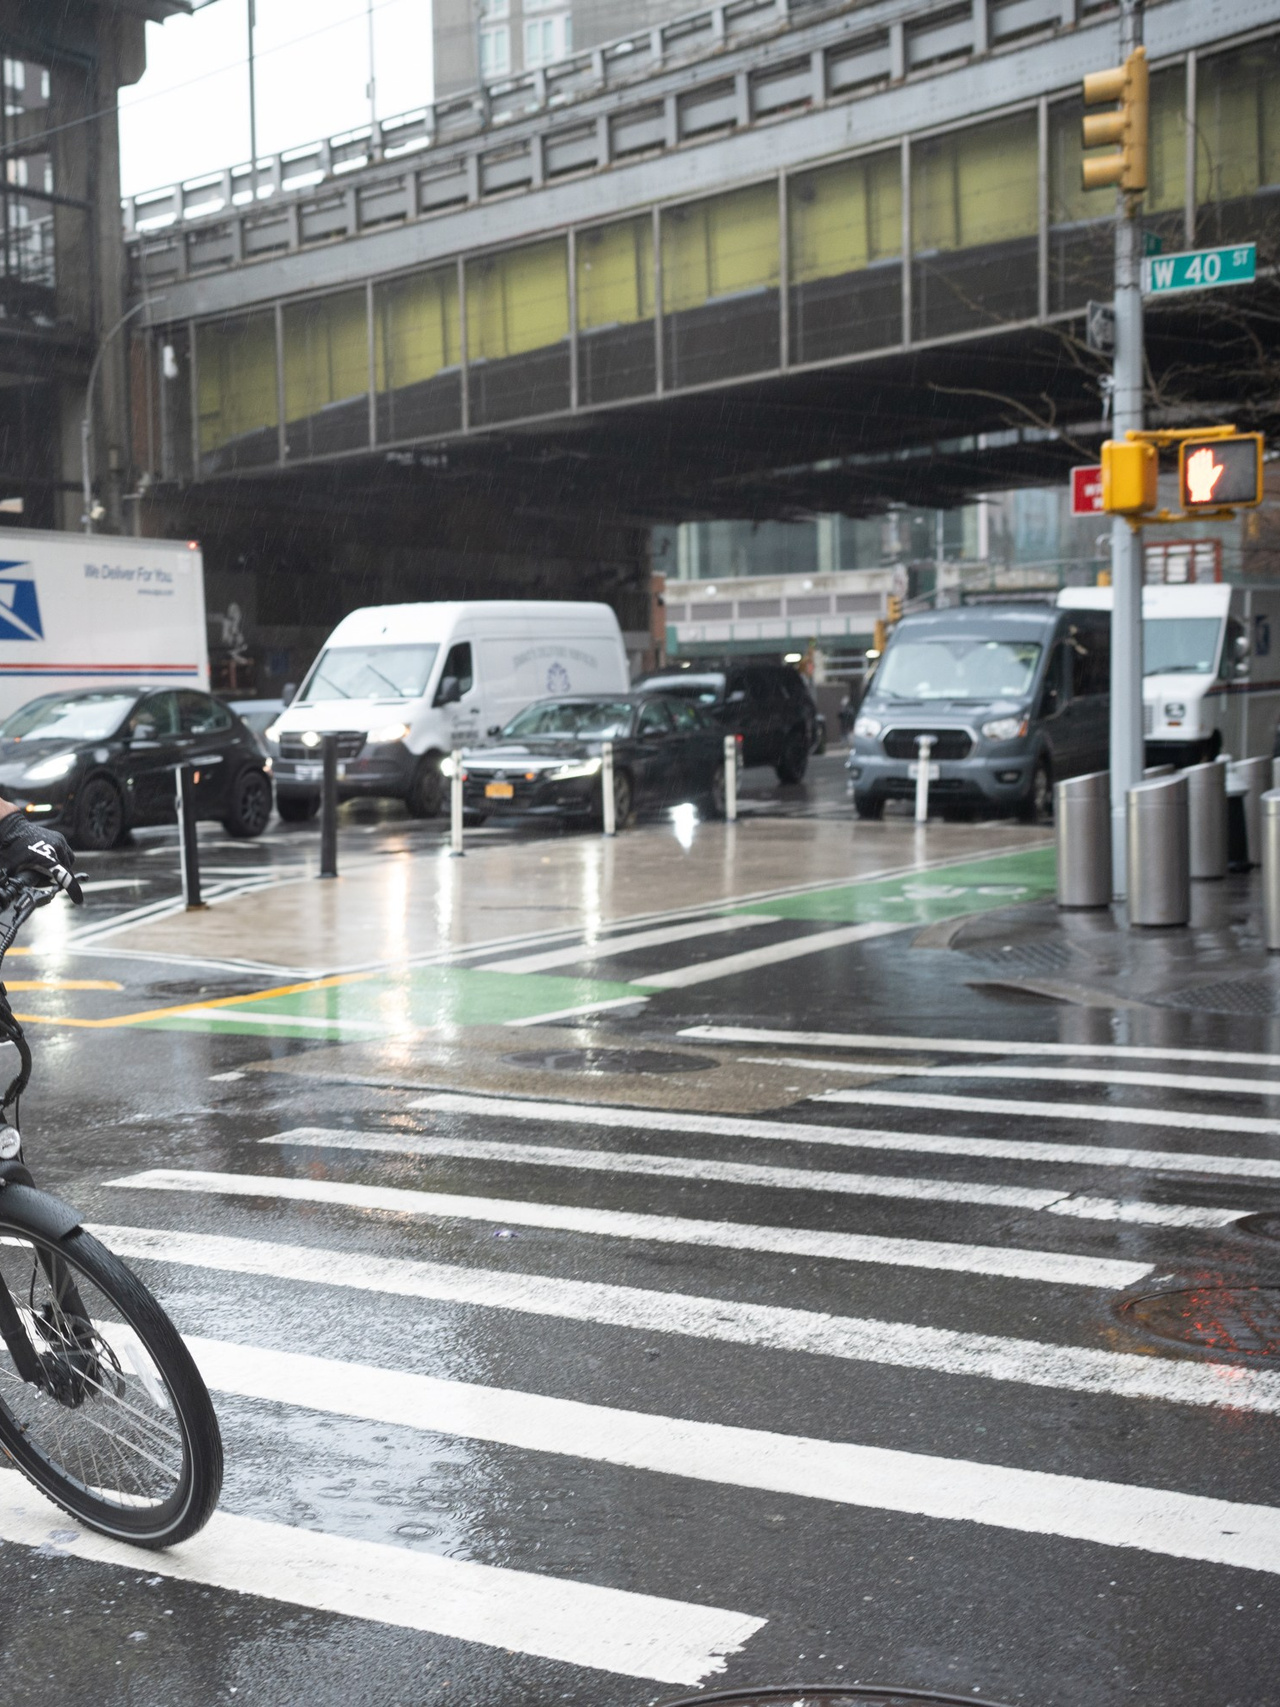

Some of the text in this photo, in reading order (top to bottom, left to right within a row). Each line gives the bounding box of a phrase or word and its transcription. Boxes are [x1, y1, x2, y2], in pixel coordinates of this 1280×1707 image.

[1154, 249, 1249, 289] W 40 ST
[84, 564, 99, 578] We
[101, 564, 136, 580] Deliver
[137, 566, 152, 582] For
